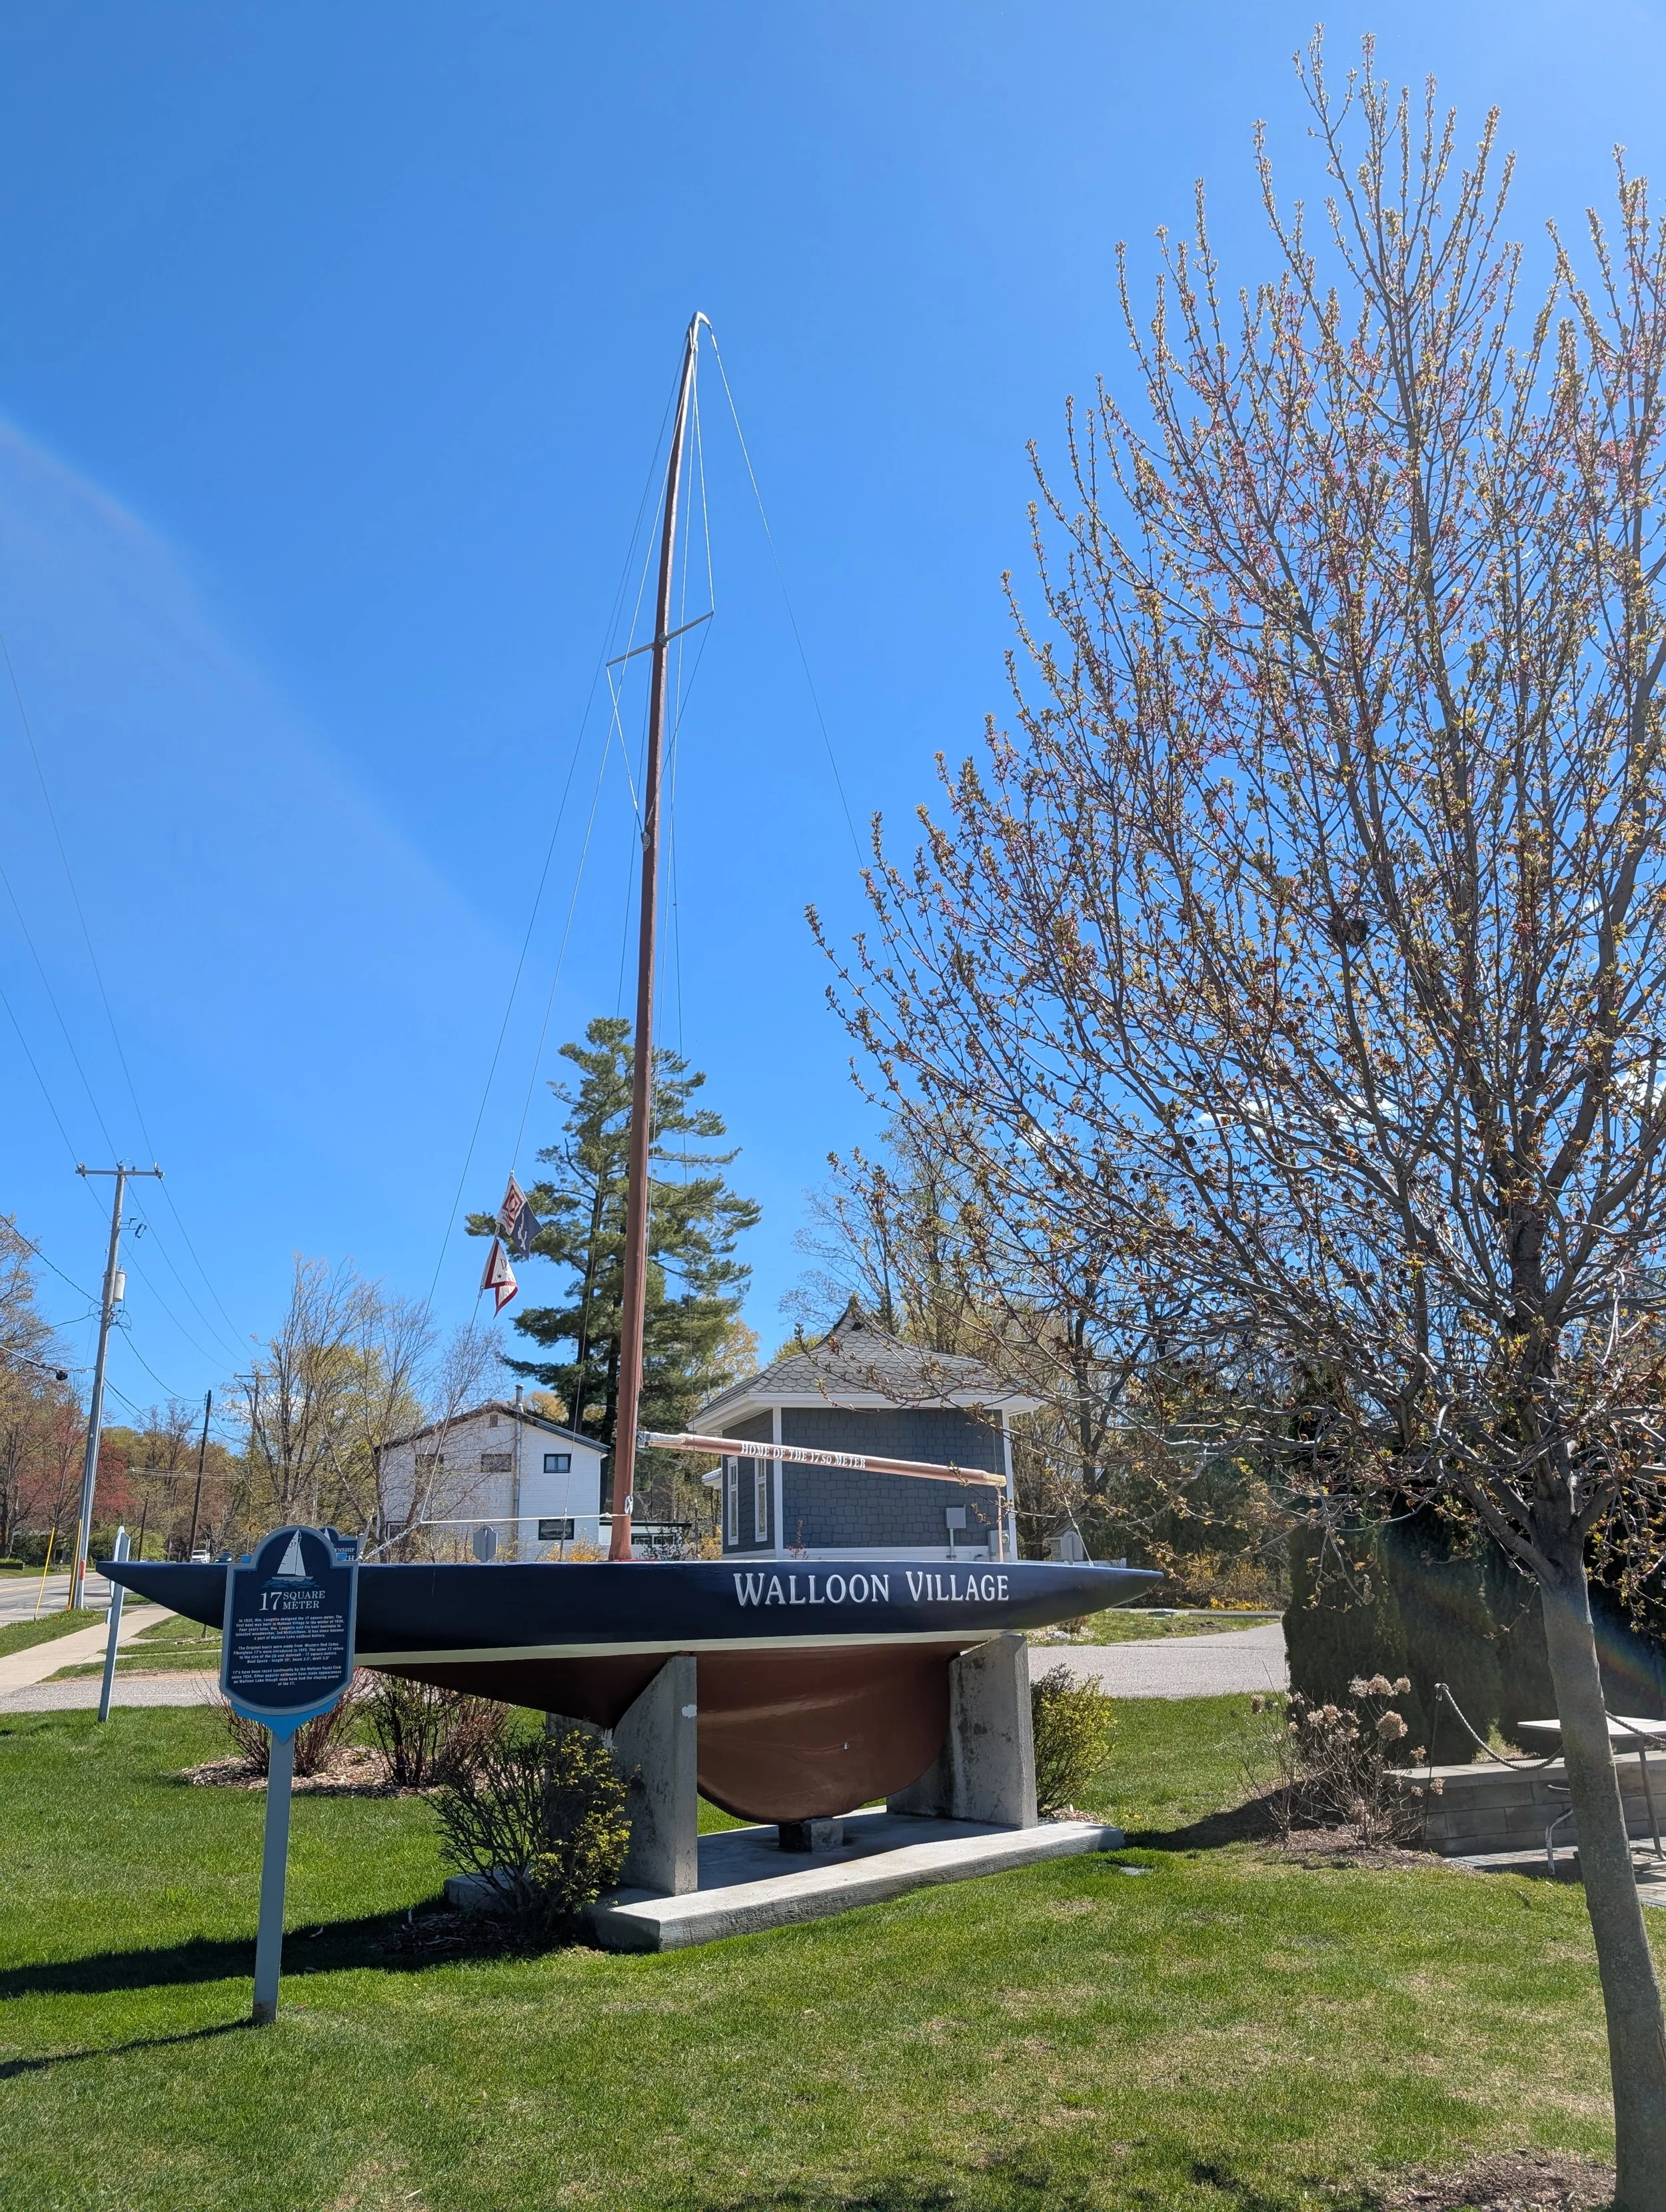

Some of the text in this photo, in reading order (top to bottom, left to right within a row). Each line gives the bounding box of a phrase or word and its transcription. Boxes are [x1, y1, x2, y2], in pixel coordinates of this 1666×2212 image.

[740, 1443, 866, 1468] HOME OF THE 17 SQ METER
[733, 1570, 1010, 1607] WALLOON VILLAGE
[259, 1590, 325, 1611] 17 SQUARE
[283, 1600, 319, 1610] METER
